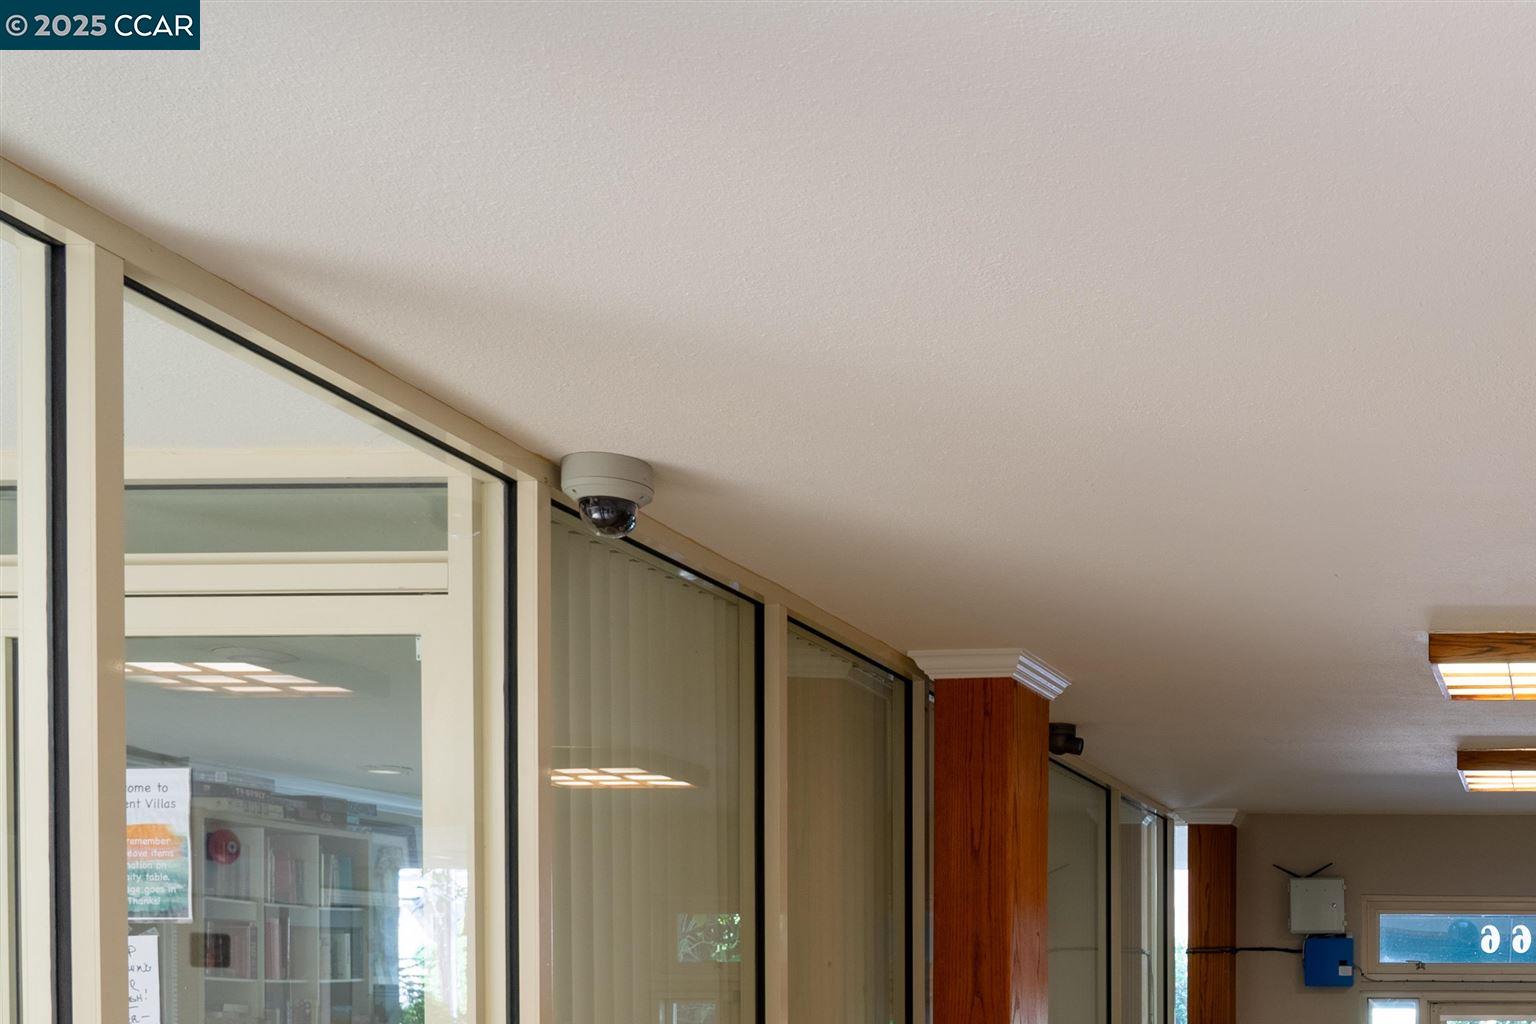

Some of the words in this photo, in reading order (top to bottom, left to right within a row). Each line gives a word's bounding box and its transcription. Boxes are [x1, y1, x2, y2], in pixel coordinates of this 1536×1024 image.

[126, 784, 151, 793] ome
[157, 782, 168, 793] to
[145, 798, 177, 809] Villas
